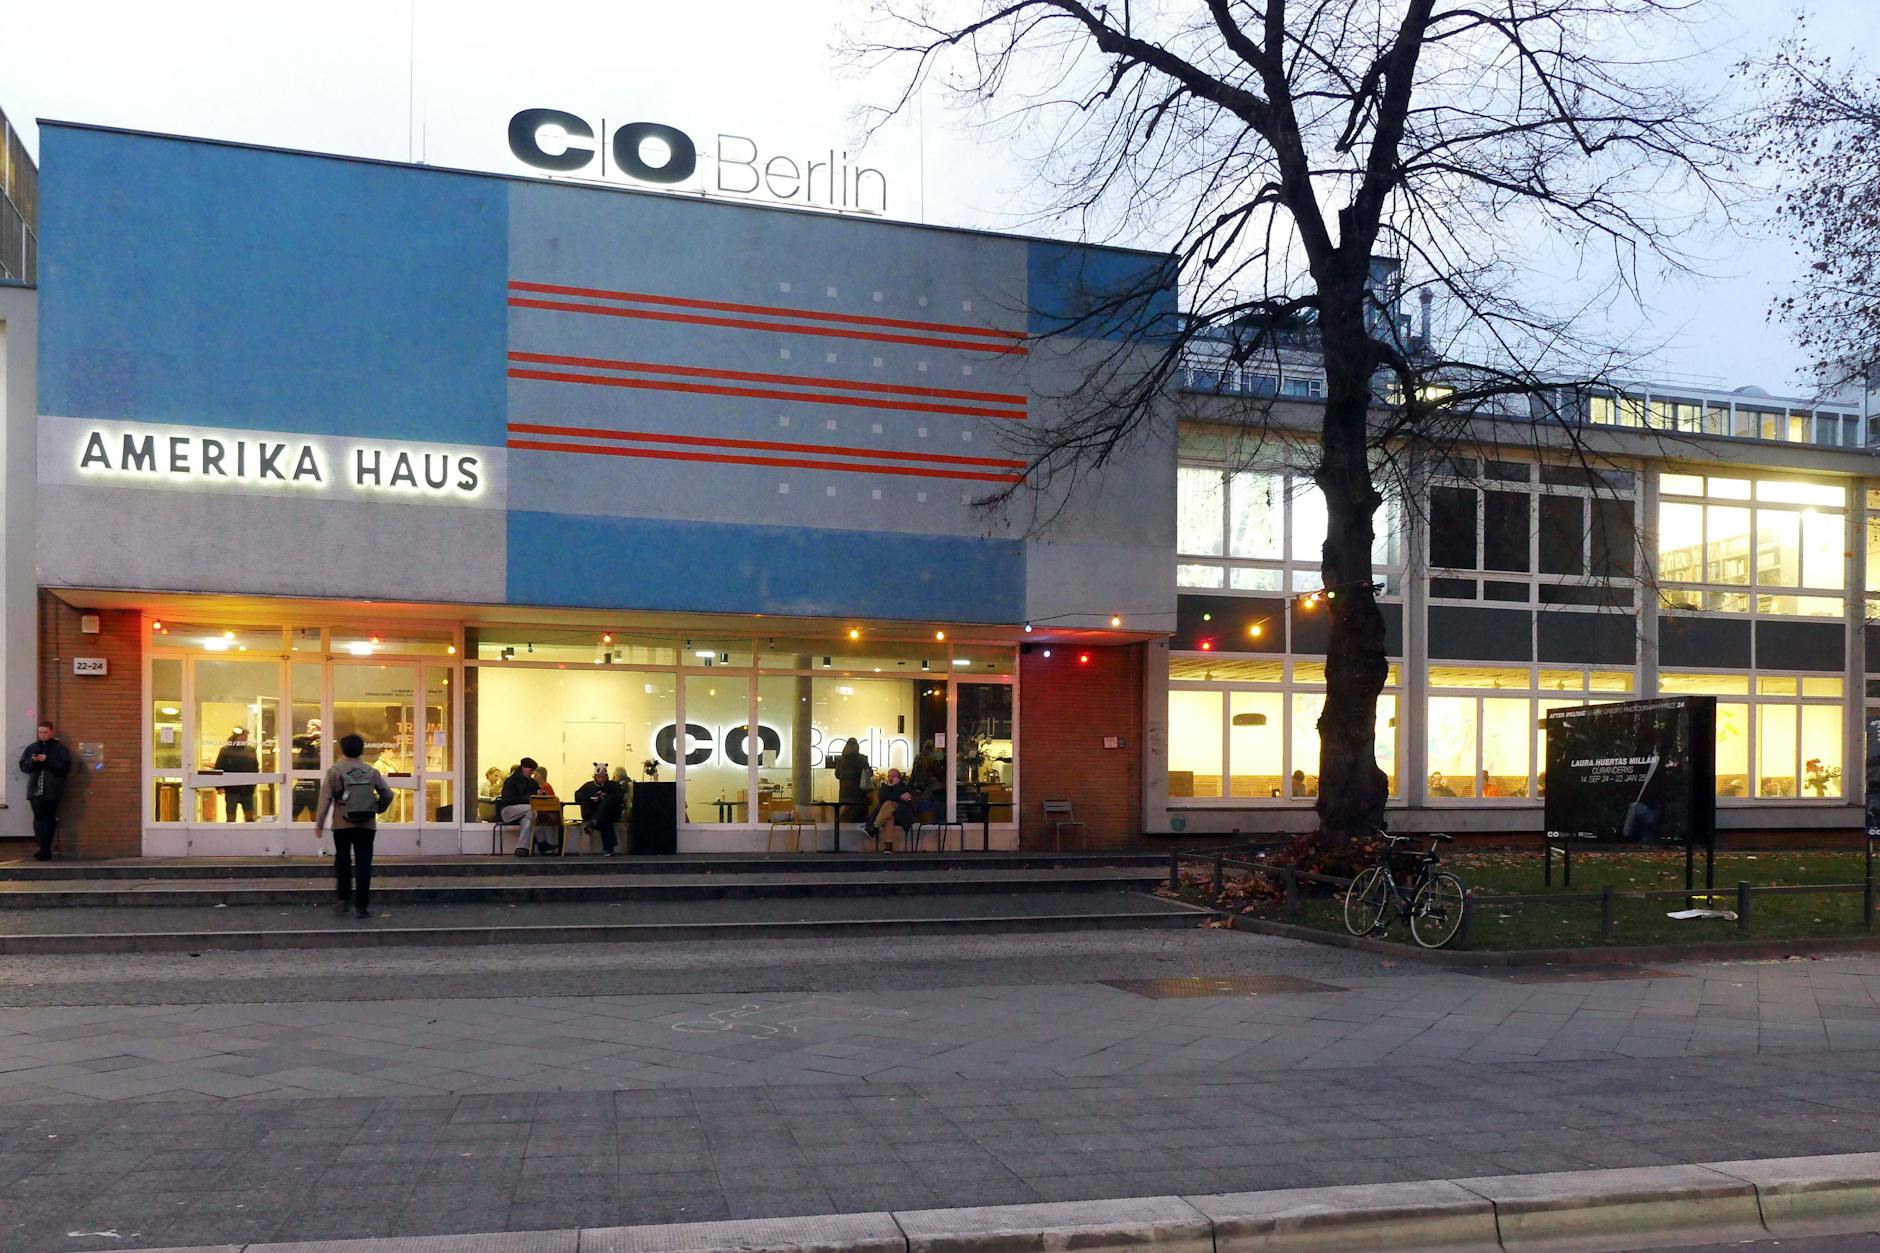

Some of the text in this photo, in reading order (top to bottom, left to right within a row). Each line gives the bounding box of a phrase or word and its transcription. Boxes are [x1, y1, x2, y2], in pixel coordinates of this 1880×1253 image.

[717, 133, 887, 211] Berlin
[80, 431, 479, 491] AMERIKA HAUS
[1571, 759, 1594, 767] LAURA
[1595, 758, 1627, 767] HUERTAS
[1588, 775, 1601, 783] SEP
[1624, 774, 1638, 782] JAN
